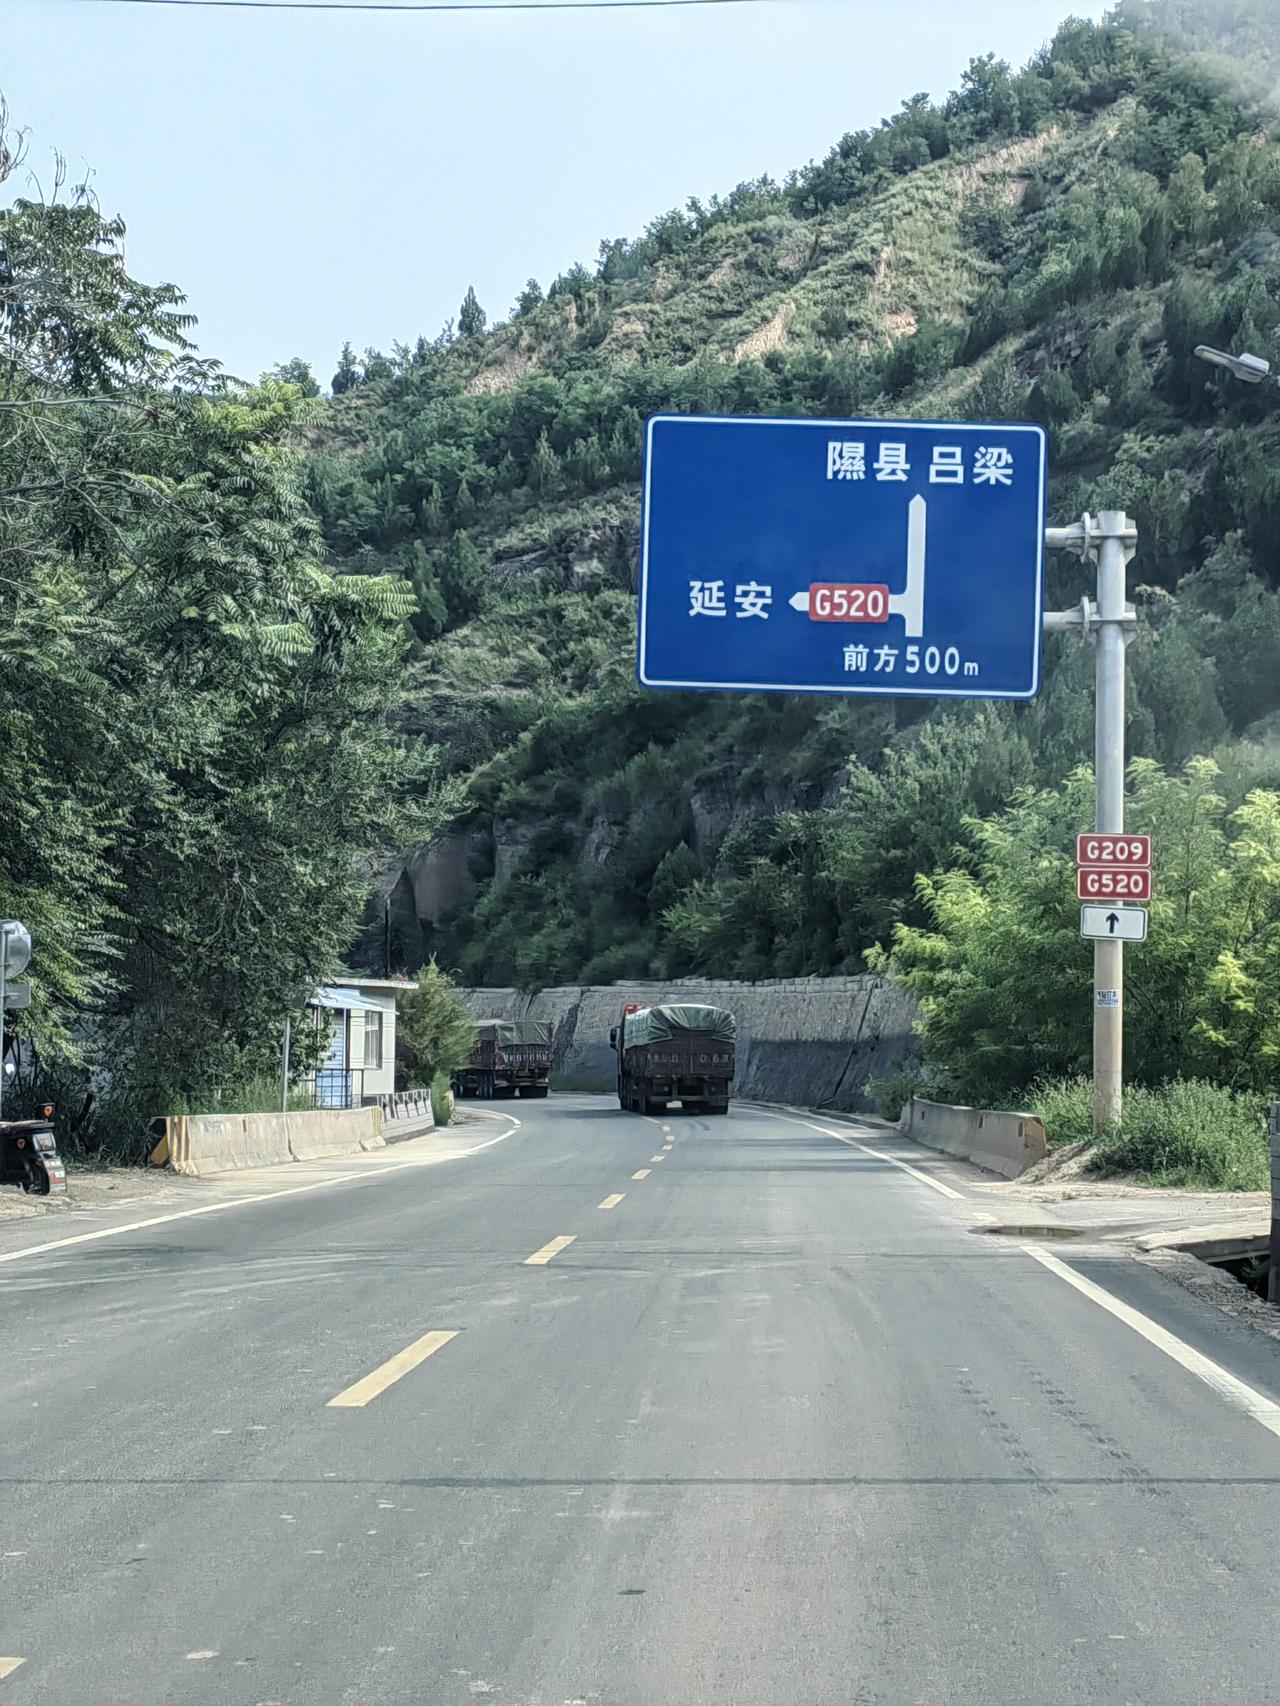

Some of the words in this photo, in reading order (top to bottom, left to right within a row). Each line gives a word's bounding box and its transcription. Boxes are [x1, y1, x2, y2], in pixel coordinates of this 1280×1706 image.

[826, 441, 911, 482] 隰县
[928, 445, 1014, 486] 吕梁
[688, 580, 773, 619] 延安
[815, 588, 884, 618] G520
[1086, 840, 1144, 861] G209
[1086, 873, 1144, 894] G520
